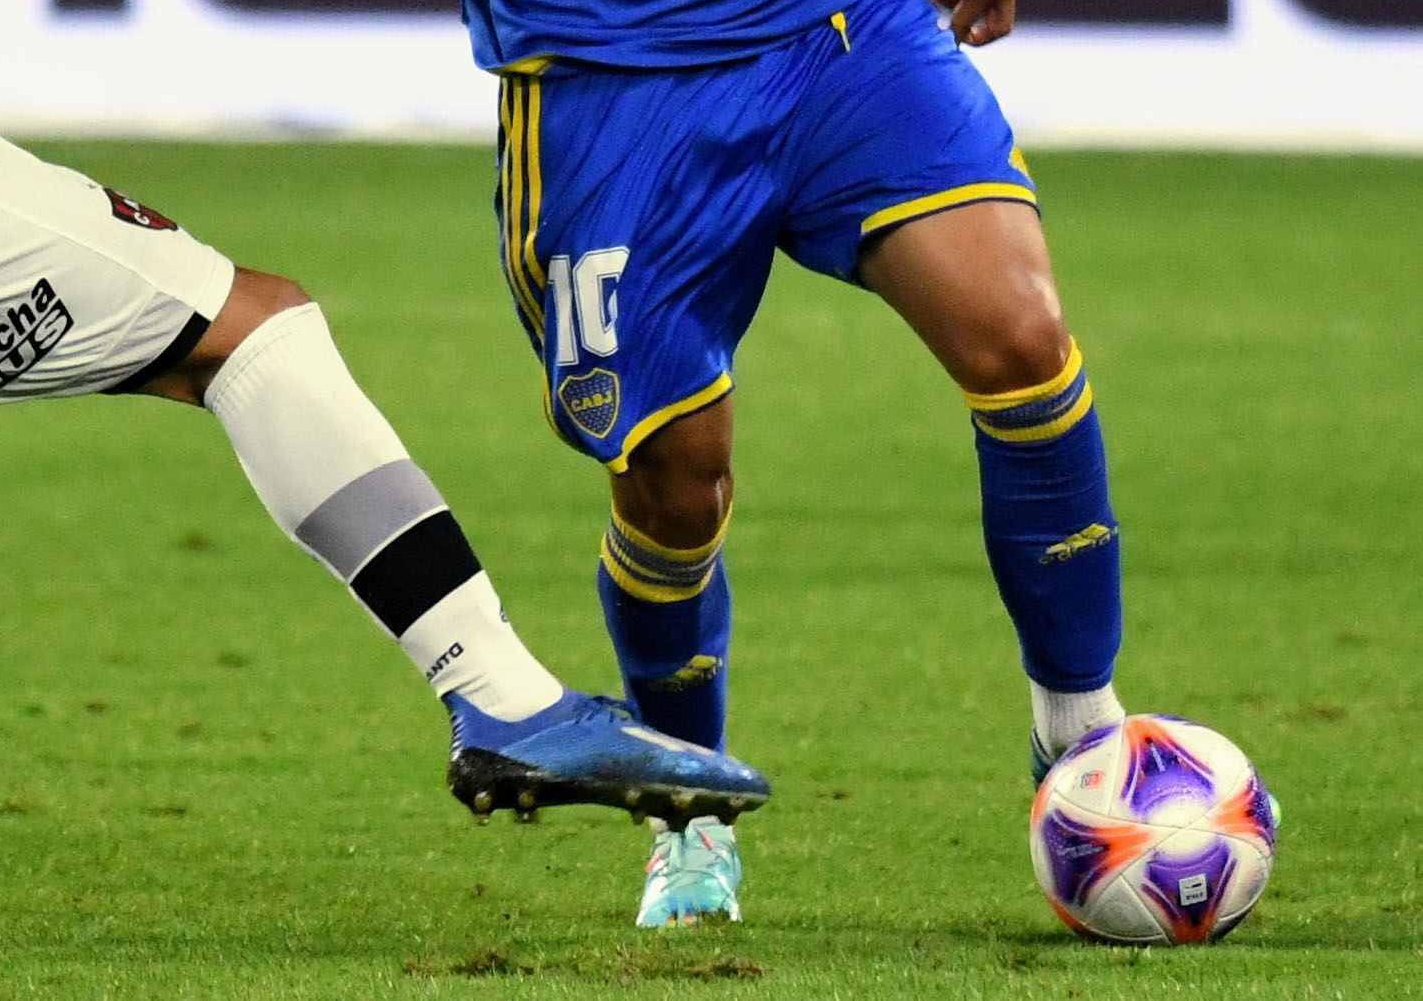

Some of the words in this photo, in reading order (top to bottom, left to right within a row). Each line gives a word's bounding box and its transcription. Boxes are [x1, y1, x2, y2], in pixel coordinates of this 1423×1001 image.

[548, 246, 631, 367] 10
[571, 391, 613, 412] CABJ
[425, 642, 464, 683] ANTO
